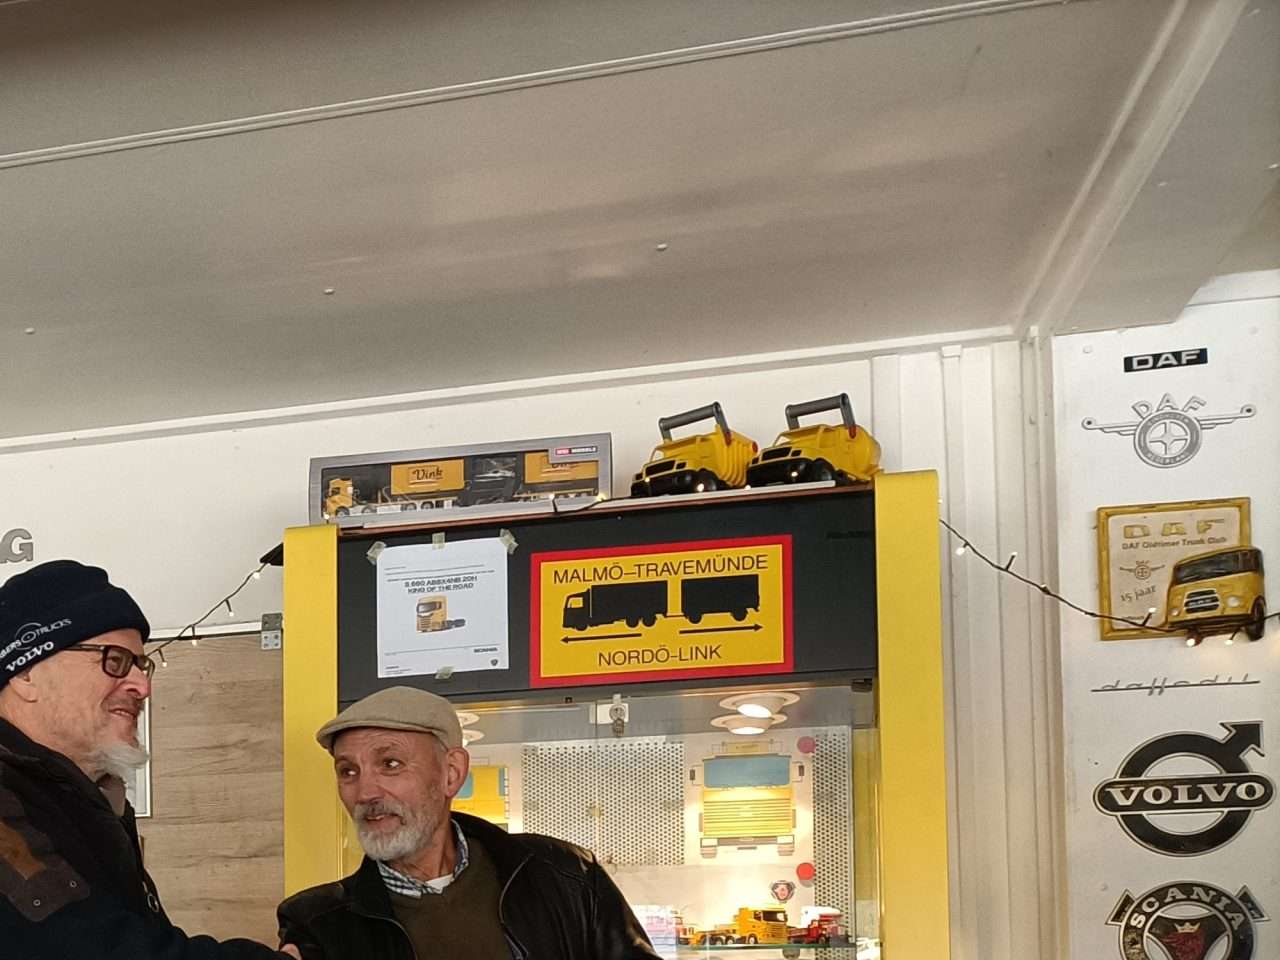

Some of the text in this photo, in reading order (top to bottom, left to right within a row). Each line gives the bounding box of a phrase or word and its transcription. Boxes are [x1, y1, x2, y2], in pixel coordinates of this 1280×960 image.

[1131, 349, 1201, 371] DAF
[1131, 392, 1207, 420] DAF
[412, 466, 443, 481] Vink
[1123, 518, 1225, 539] DAF
[1135, 585, 1157, 600] jaar
[6, 641, 55, 673] VOLVO
[598, 644, 722, 667] NORDÖ-LINK
[1105, 780, 1267, 806] VOLVO
[1130, 886, 1245, 931] SCANIA
